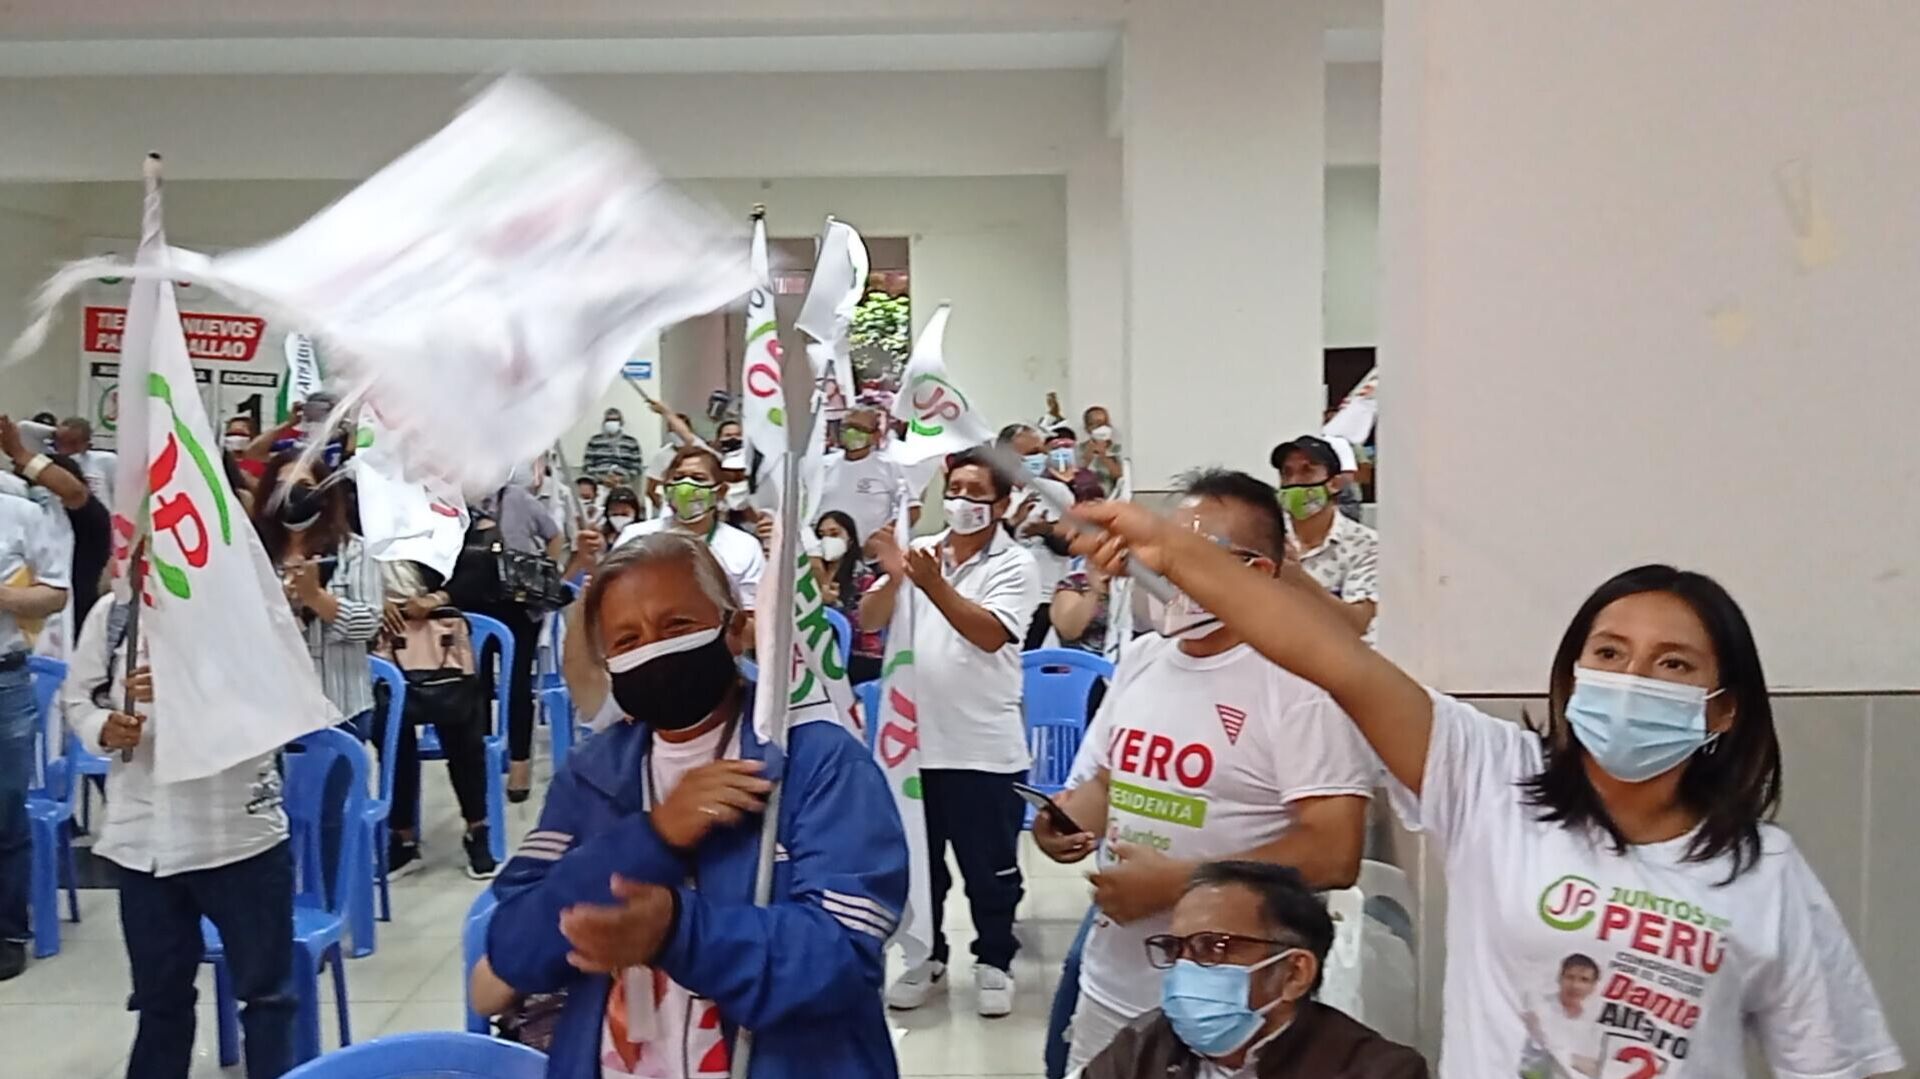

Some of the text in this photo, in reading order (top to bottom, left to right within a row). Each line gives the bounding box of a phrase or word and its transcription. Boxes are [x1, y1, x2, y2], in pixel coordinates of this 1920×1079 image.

[1606, 886, 1706, 926] JUNTOS
[1602, 972, 1702, 1030] Dante
[1597, 1002, 1690, 1060] Alfaro
